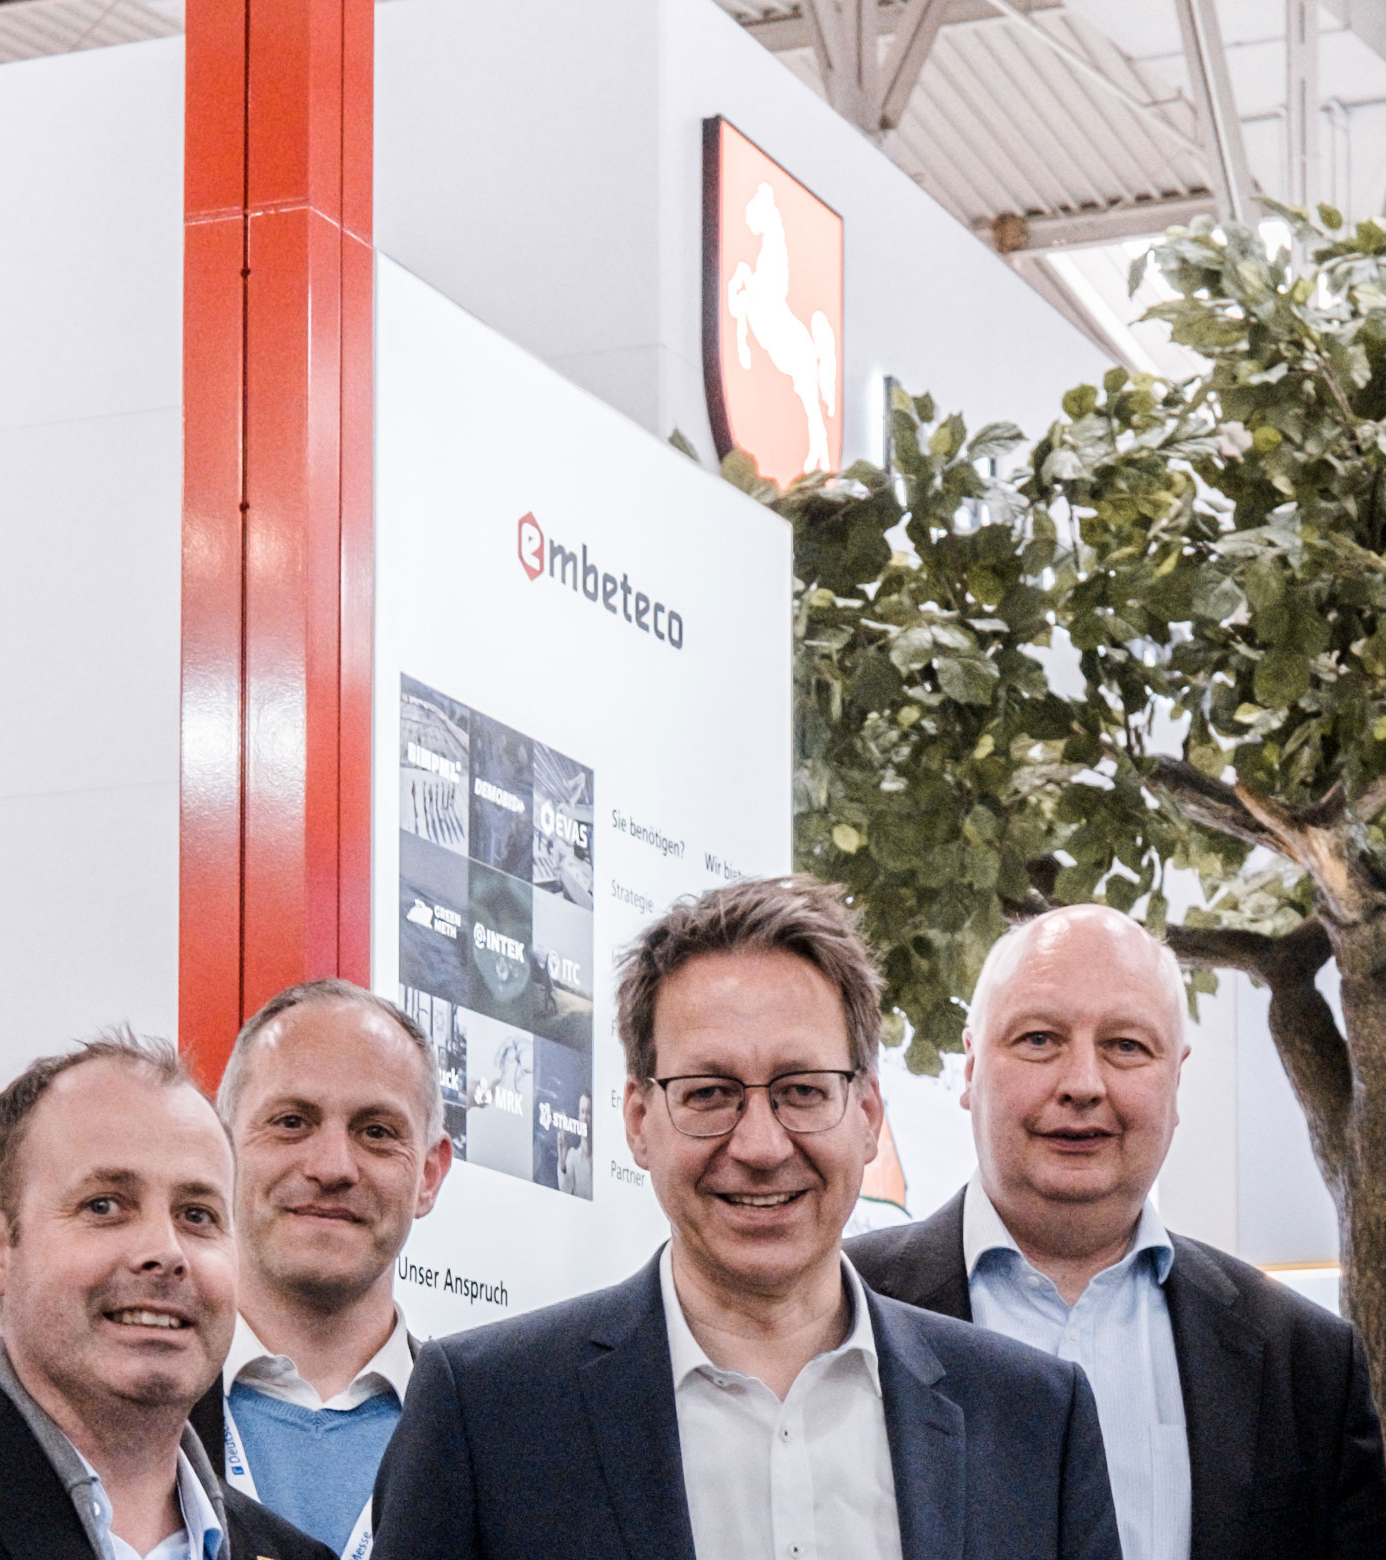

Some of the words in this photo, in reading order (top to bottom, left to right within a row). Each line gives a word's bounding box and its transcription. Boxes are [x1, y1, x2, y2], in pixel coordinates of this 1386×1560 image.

[555, 812, 588, 849] EVAS
[612, 809, 627, 833] Sie
[629, 816, 685, 859] benötigen?
[704, 851, 721, 876] Wir
[611, 879, 654, 915] Strategie
[611, 1159, 645, 1188] Partner
[398, 1254, 440, 1289] Unser
[443, 1267, 509, 1308] Anspruch
